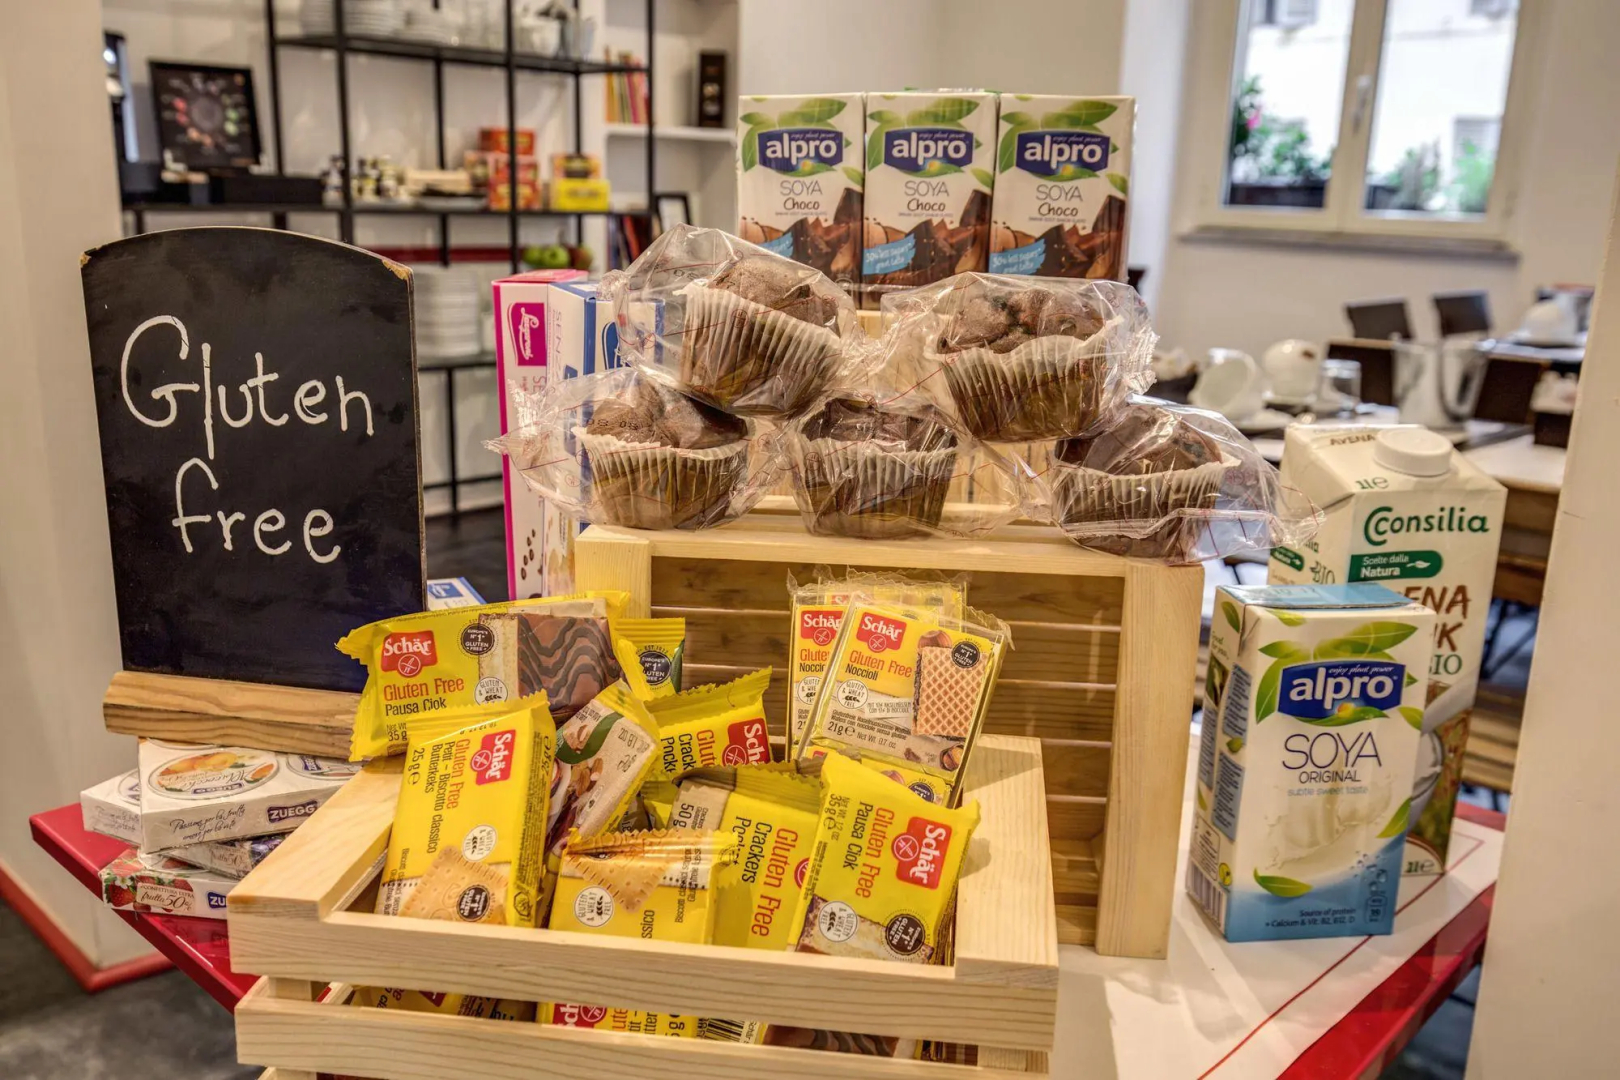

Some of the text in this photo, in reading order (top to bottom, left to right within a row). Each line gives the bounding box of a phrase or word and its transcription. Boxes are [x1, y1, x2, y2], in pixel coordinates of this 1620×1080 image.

[766, 133, 837, 165] alpro
[892, 132, 966, 166] alpro
[1024, 135, 1102, 170] alpro
[780, 180, 823, 196] SOYA
[904, 180, 950, 196] SOYA
[1036, 184, 1083, 202] SOYA
[784, 198, 820, 210] Choco
[907, 198, 946, 212] Choco
[1038, 202, 1078, 216] Choco
[121, 315, 374, 460] Gluten
[1330, 434, 1376, 446] AVENA
[172, 457, 342, 563] free
[1361, 566, 1400, 578] Natura
[1402, 584, 1472, 620] ENA
[862, 616, 903, 641] Schär
[383, 638, 432, 656] Schär
[800, 649, 830, 662] Glute
[845, 664, 879, 680] Noccioli
[850, 650, 912, 678] Gluten Free
[1328, 665, 1394, 675] enjoy plant power
[1429, 654, 1463, 675] IO
[384, 678, 464, 700] Gluten Free
[480, 680, 500, 688] GLUTEN
[846, 681, 864, 690] GLUTEN
[848, 688, 864, 697] WHEAT
[1289, 667, 1394, 710] alpro
[386, 697, 447, 716] Pausa Ciok
[386, 723, 398, 732] Net
[388, 731, 408, 742] 35 g
[485, 732, 512, 779] Schär
[678, 734, 697, 771] Crack
[696, 728, 718, 768] Glut
[744, 722, 766, 766] Sch
[1282, 732, 1382, 770] SOYA
[408, 748, 425, 772] 25 g
[424, 743, 444, 794] Butterkeks
[446, 738, 472, 810] Gluten Free
[1298, 770, 1362, 784] ORIGINAL
[426, 740, 456, 854] Petit Biscotto classico
[1288, 785, 1368, 797] subtle sweet taste
[269, 805, 316, 820] ZUEGG
[672, 802, 695, 828] 50 g
[824, 793, 842, 816] 35 g
[842, 802, 874, 871] Pausa Ciok
[742, 822, 772, 884] Crackers
[855, 806, 895, 899] Gluten Free
[910, 824, 947, 884] Schär
[752, 828, 798, 936] Gluten Free
[140, 892, 166, 902] frutta
[209, 896, 226, 906] ZU
[577, 894, 588, 918] GLUTEN
[587, 892, 597, 914] WHEAT
[1324, 908, 1332, 916] of
[1332, 908, 1356, 916] protein
[641, 910, 656, 939] ssico
[834, 914, 844, 938] WHEAT
[844, 913, 855, 936] GLUTEN
[890, 920, 898, 938] FREE
[894, 918, 908, 946] GLUTEN
[1271, 920, 1298, 928] Calcium
